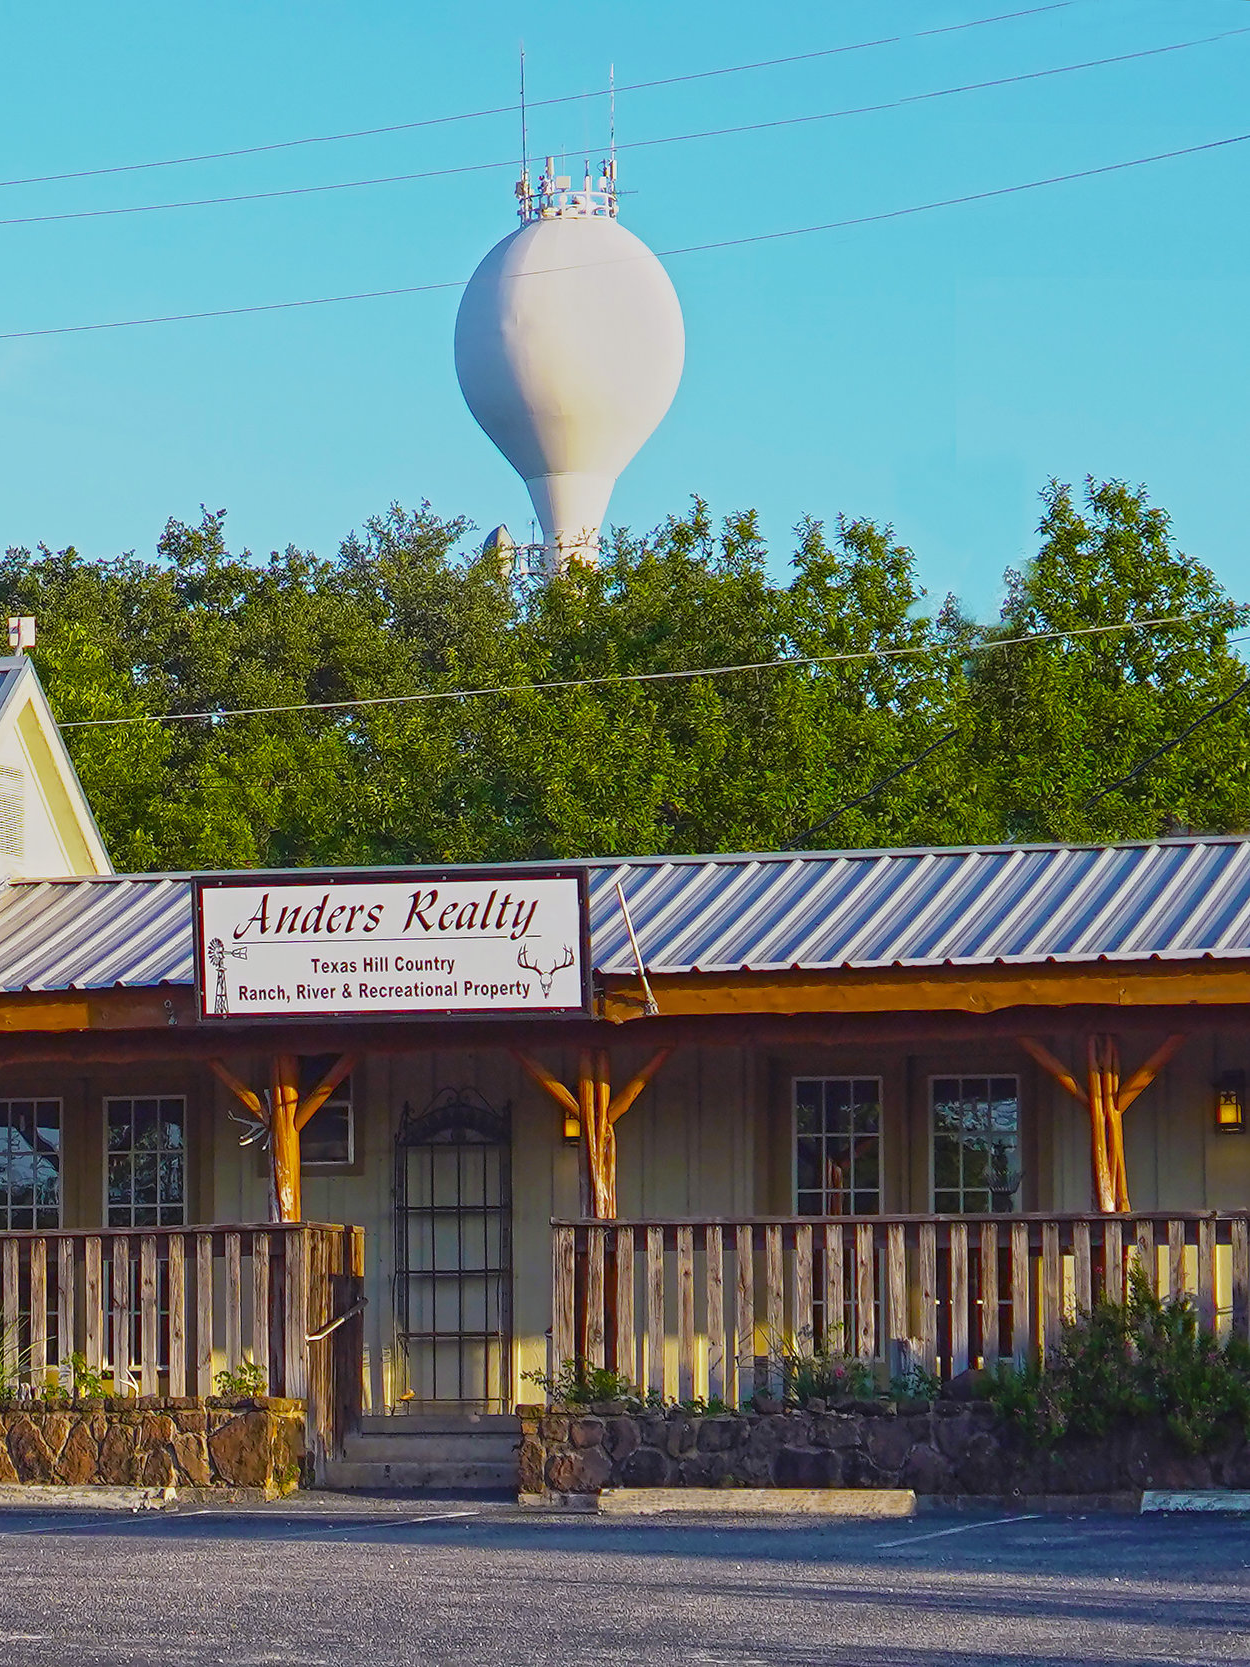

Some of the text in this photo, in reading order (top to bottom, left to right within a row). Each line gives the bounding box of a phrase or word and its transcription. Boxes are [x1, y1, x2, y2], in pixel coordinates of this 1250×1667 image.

[232, 888, 540, 941] Anders Realty
[310, 956, 455, 975] Texas Hill Country
[238, 980, 531, 1003] Ranch, River & Recreational Property
